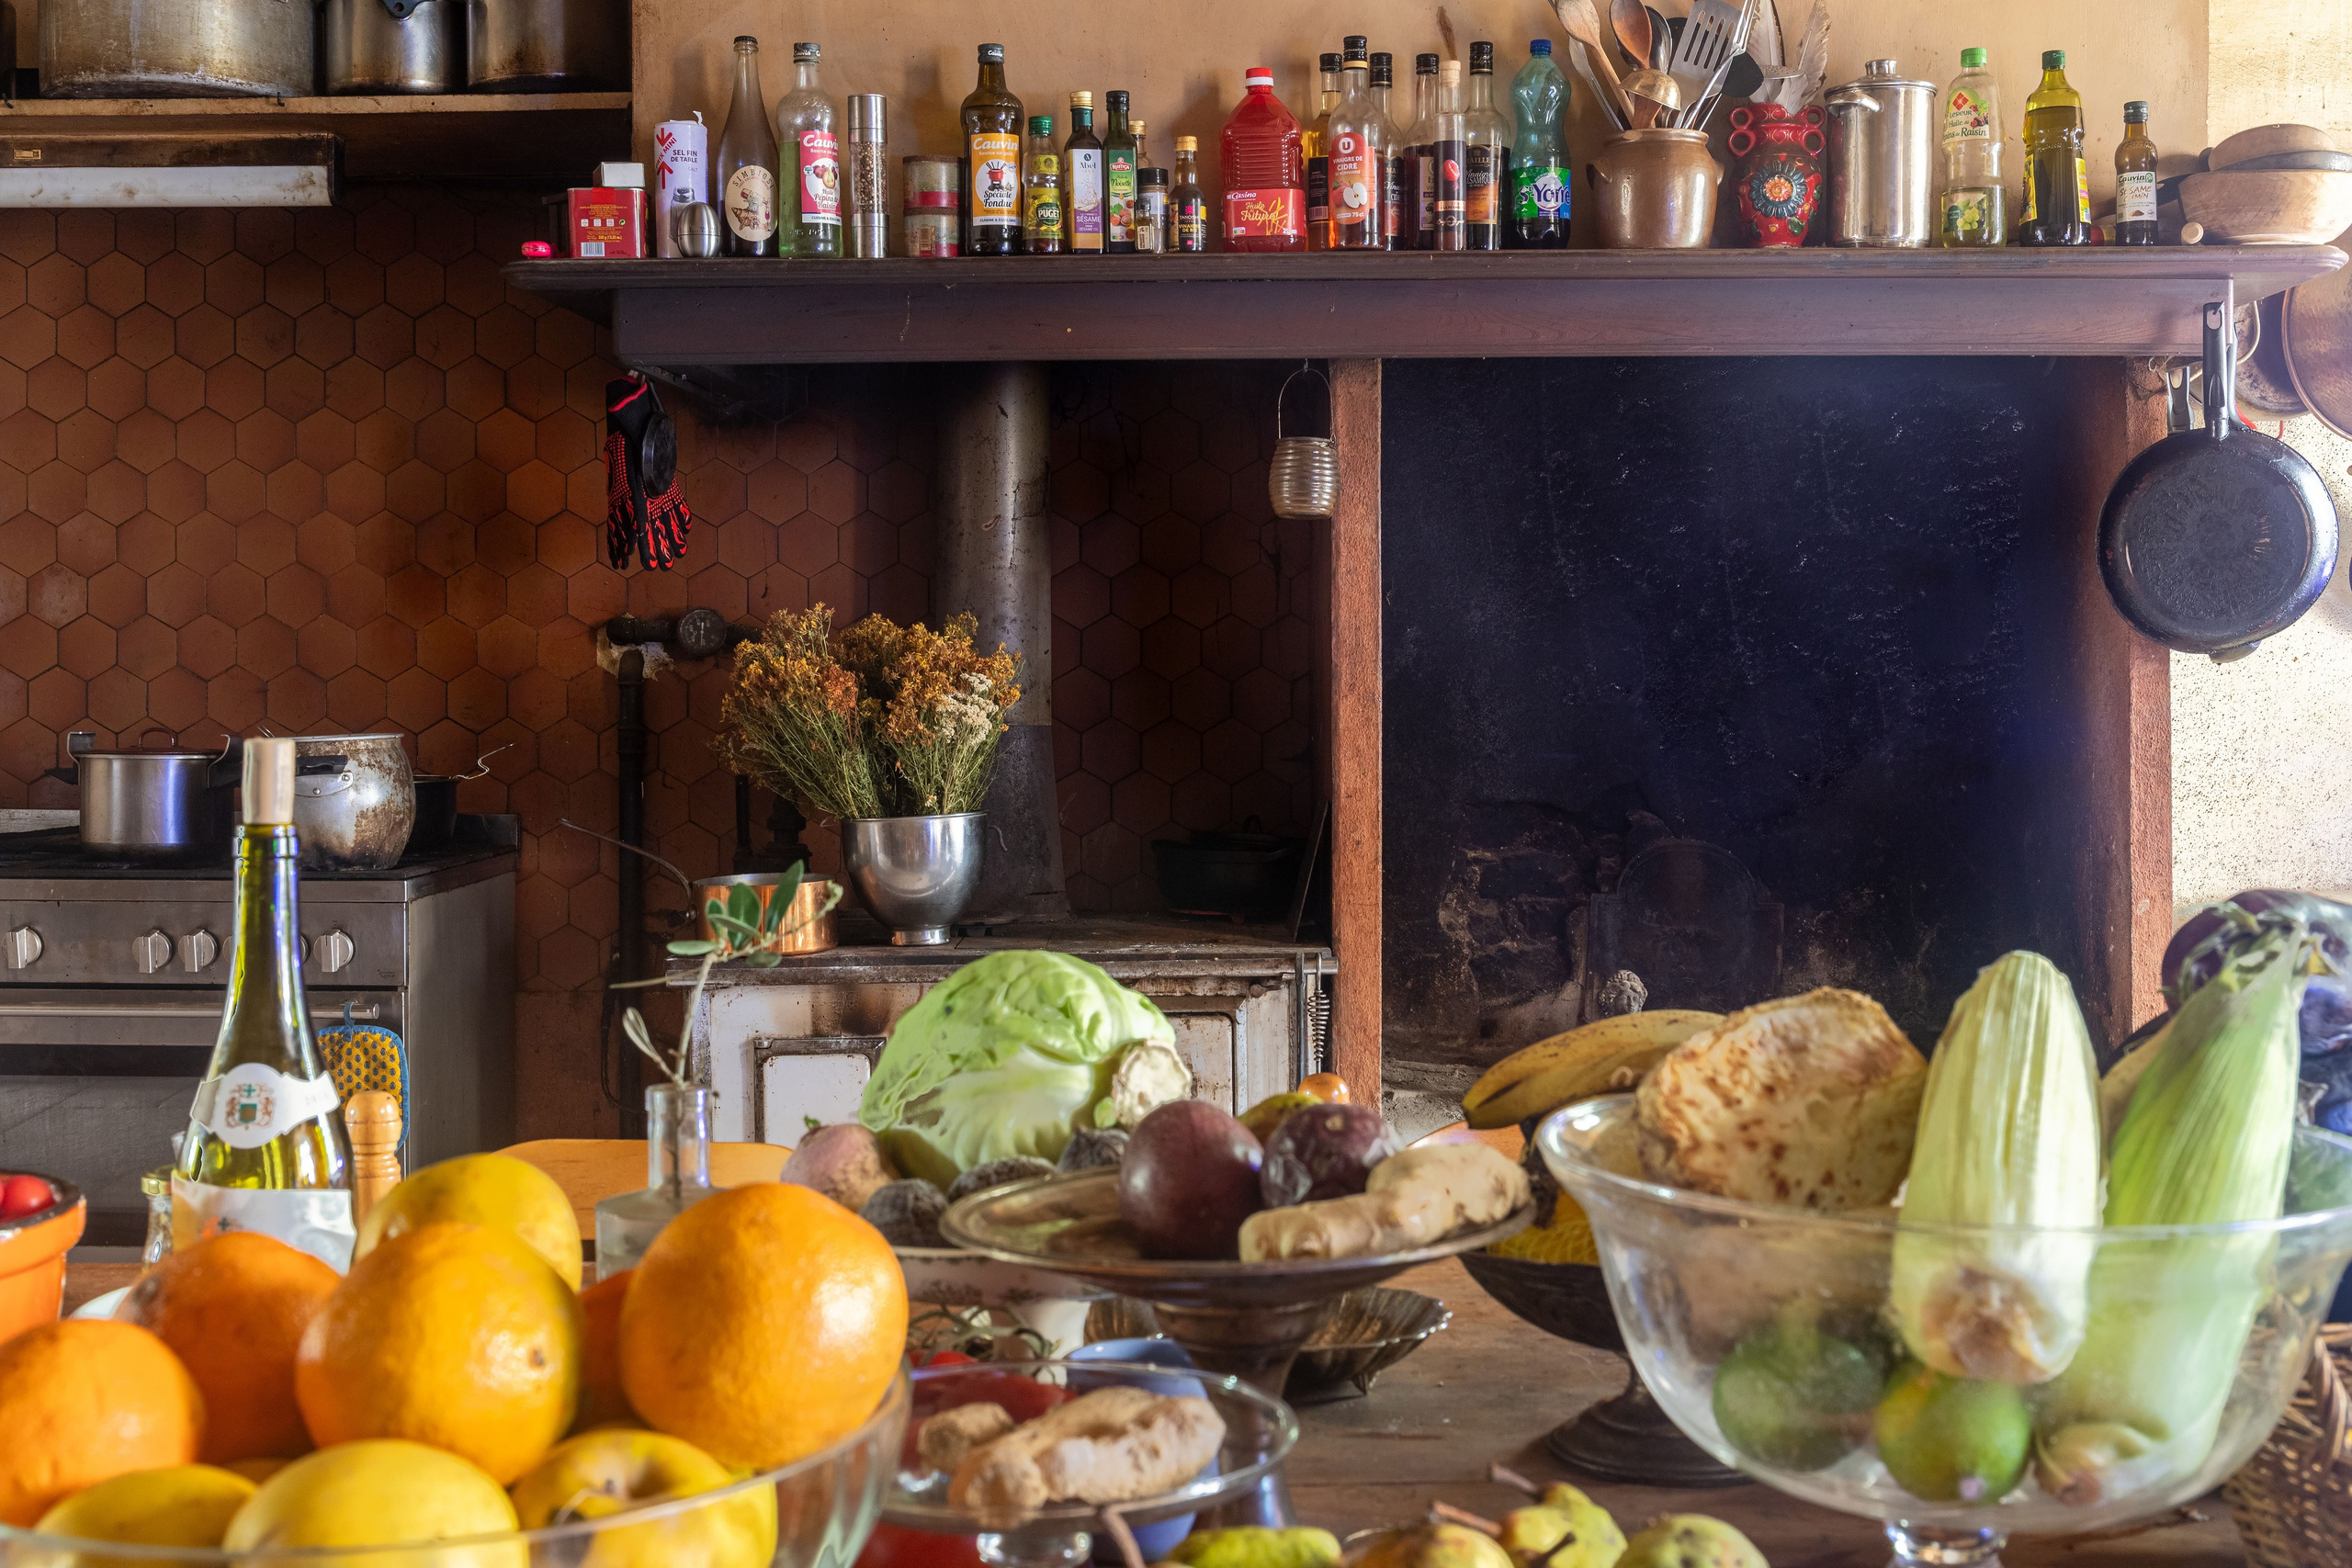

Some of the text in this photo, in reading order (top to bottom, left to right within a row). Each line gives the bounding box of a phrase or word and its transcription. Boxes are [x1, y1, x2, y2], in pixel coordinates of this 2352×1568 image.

[1961, 127, 1986, 137] Raisin
[662, 137, 677, 154] MINI
[974, 137, 1018, 151] Cauvin
[1342, 141, 1351, 151] U
[1337, 163, 1358, 171] CIDRE
[731, 169, 775, 189] SIMBIOSI
[2118, 174, 2145, 184] Cauvin
[814, 193, 834, 203] Pépins
[984, 189, 1012, 200] Spéciale
[1231, 191, 1257, 200] Casino
[817, 201, 836, 210] Raisin
[984, 198, 1012, 208] Fondue
[1245, 201, 1265, 210] Huile
[1037, 209, 1059, 218] PUGET
[1076, 215, 1101, 223] SÉSAME
